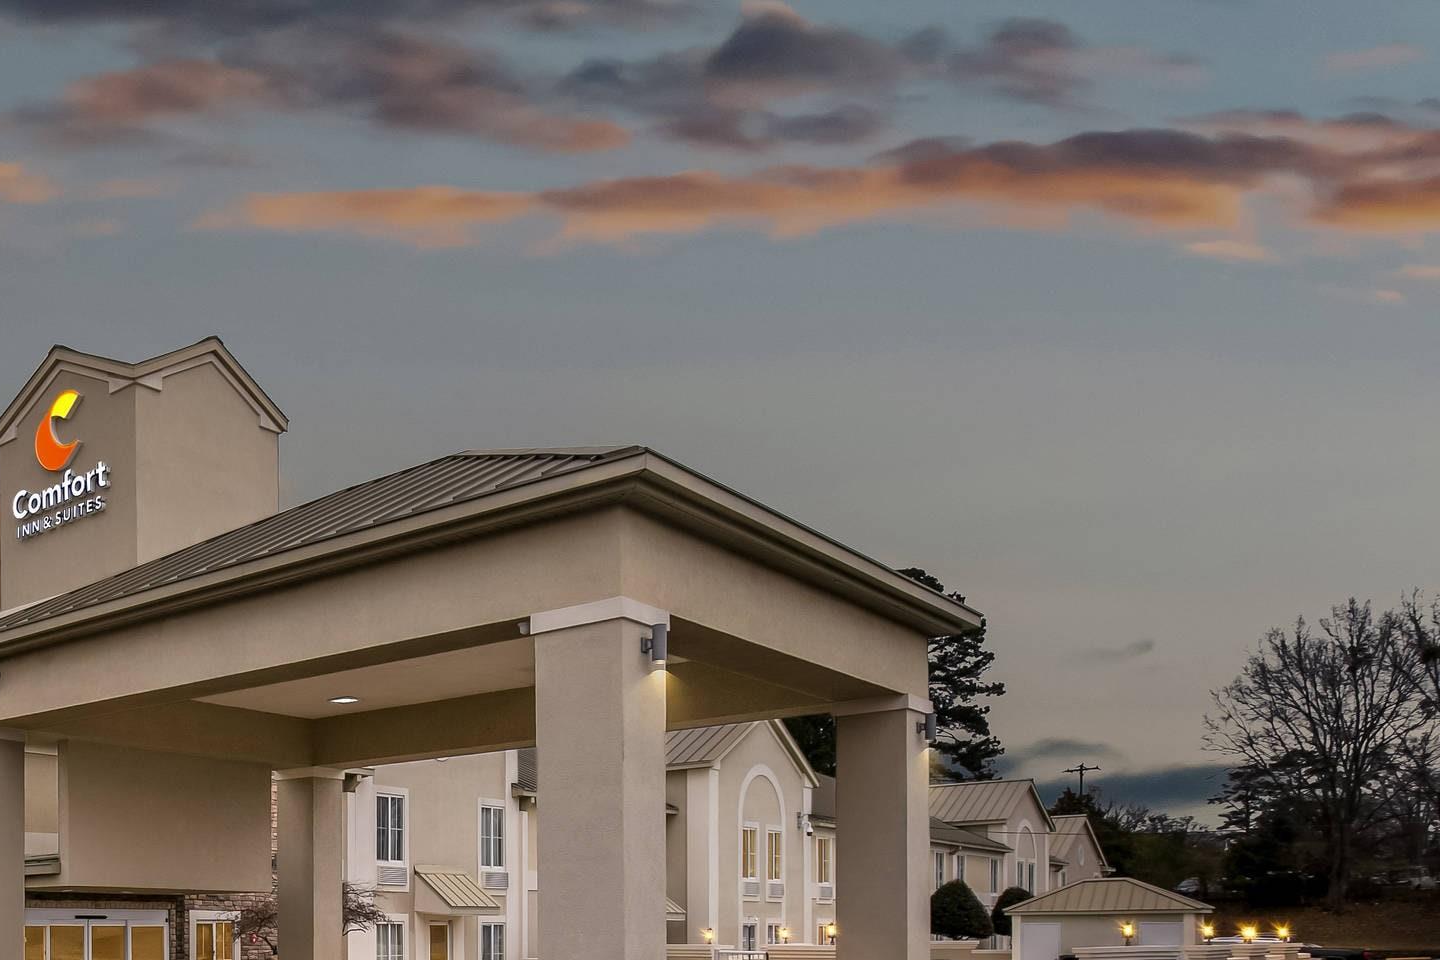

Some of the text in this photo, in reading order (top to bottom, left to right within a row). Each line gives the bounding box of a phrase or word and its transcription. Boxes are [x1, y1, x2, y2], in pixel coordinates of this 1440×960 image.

[12, 460, 107, 519] Comfort
[17, 495, 103, 539] INN & SUITES
